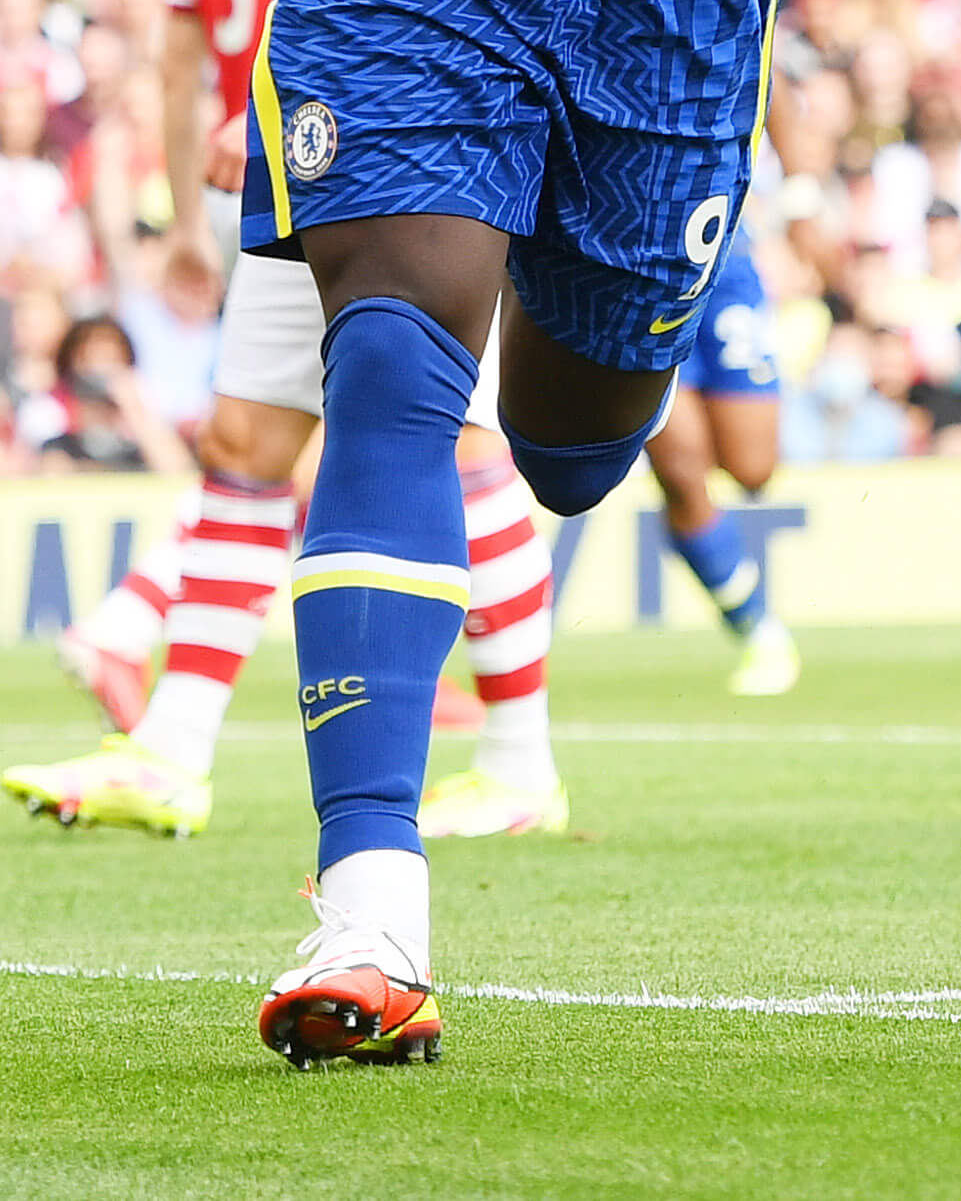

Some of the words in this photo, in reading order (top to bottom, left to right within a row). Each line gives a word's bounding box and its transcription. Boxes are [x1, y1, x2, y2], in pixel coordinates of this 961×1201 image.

[293, 105, 326, 126] CHELSEA
[677, 194, 728, 301] 9
[302, 676, 366, 704] CFC
